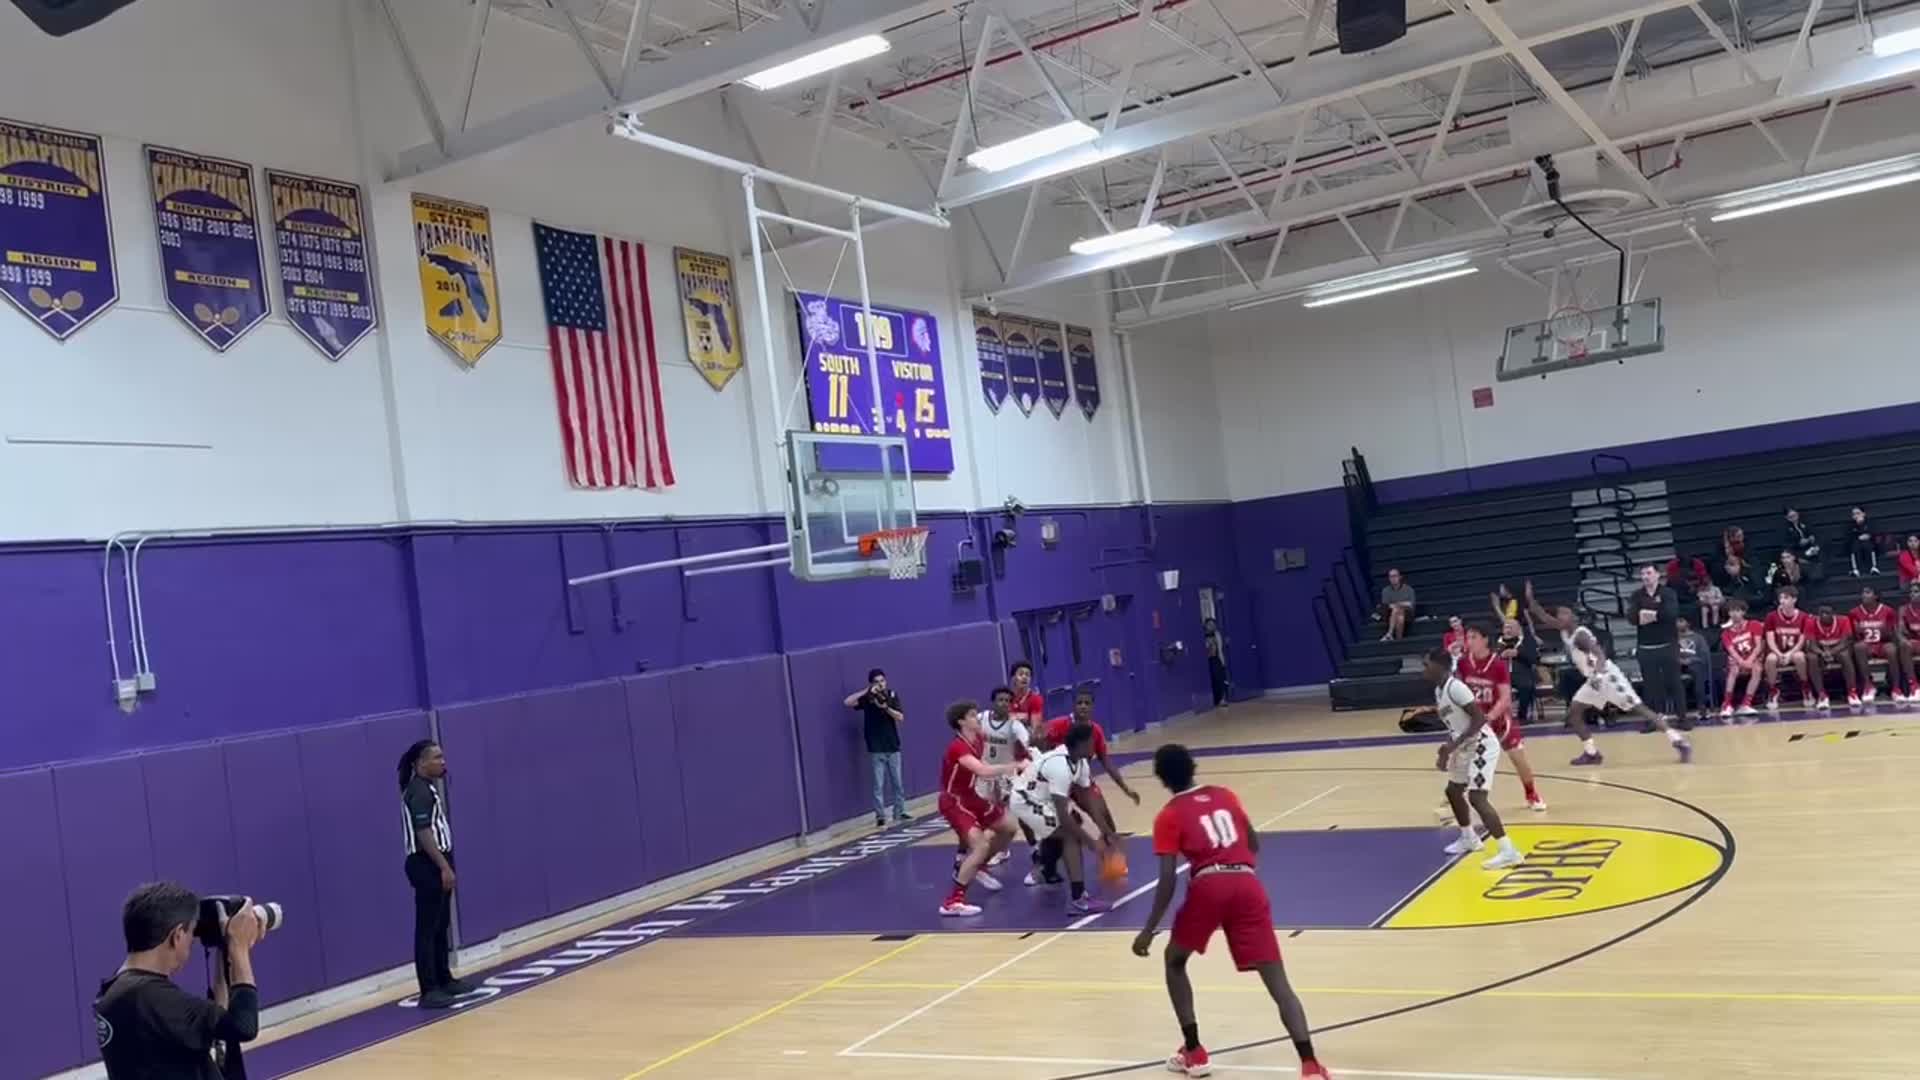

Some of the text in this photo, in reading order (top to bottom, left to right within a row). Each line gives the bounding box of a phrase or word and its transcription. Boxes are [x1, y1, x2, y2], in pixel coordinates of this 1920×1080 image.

[0, 124, 89, 147] OYS TENNIS
[0, 134, 100, 193] HAMPIONS
[7, 176, 81, 194] DISTRICT
[311, 182, 352, 196] TRACK
[0, 188, 13, 205] 98
[429, 211, 473, 230] STATE
[415, 221, 490, 266] CHAMPIONS
[21, 254, 81, 269] REGION
[187, 274, 238, 287] REGION
[818, 352, 861, 376] SOUTH
[891, 359, 935, 381] VISITOR
[828, 374, 849, 418] 11
[1863, 628, 1881, 643] 23
[1199, 809, 1238, 848] 10
[1483, 838, 1622, 900] SPHS
